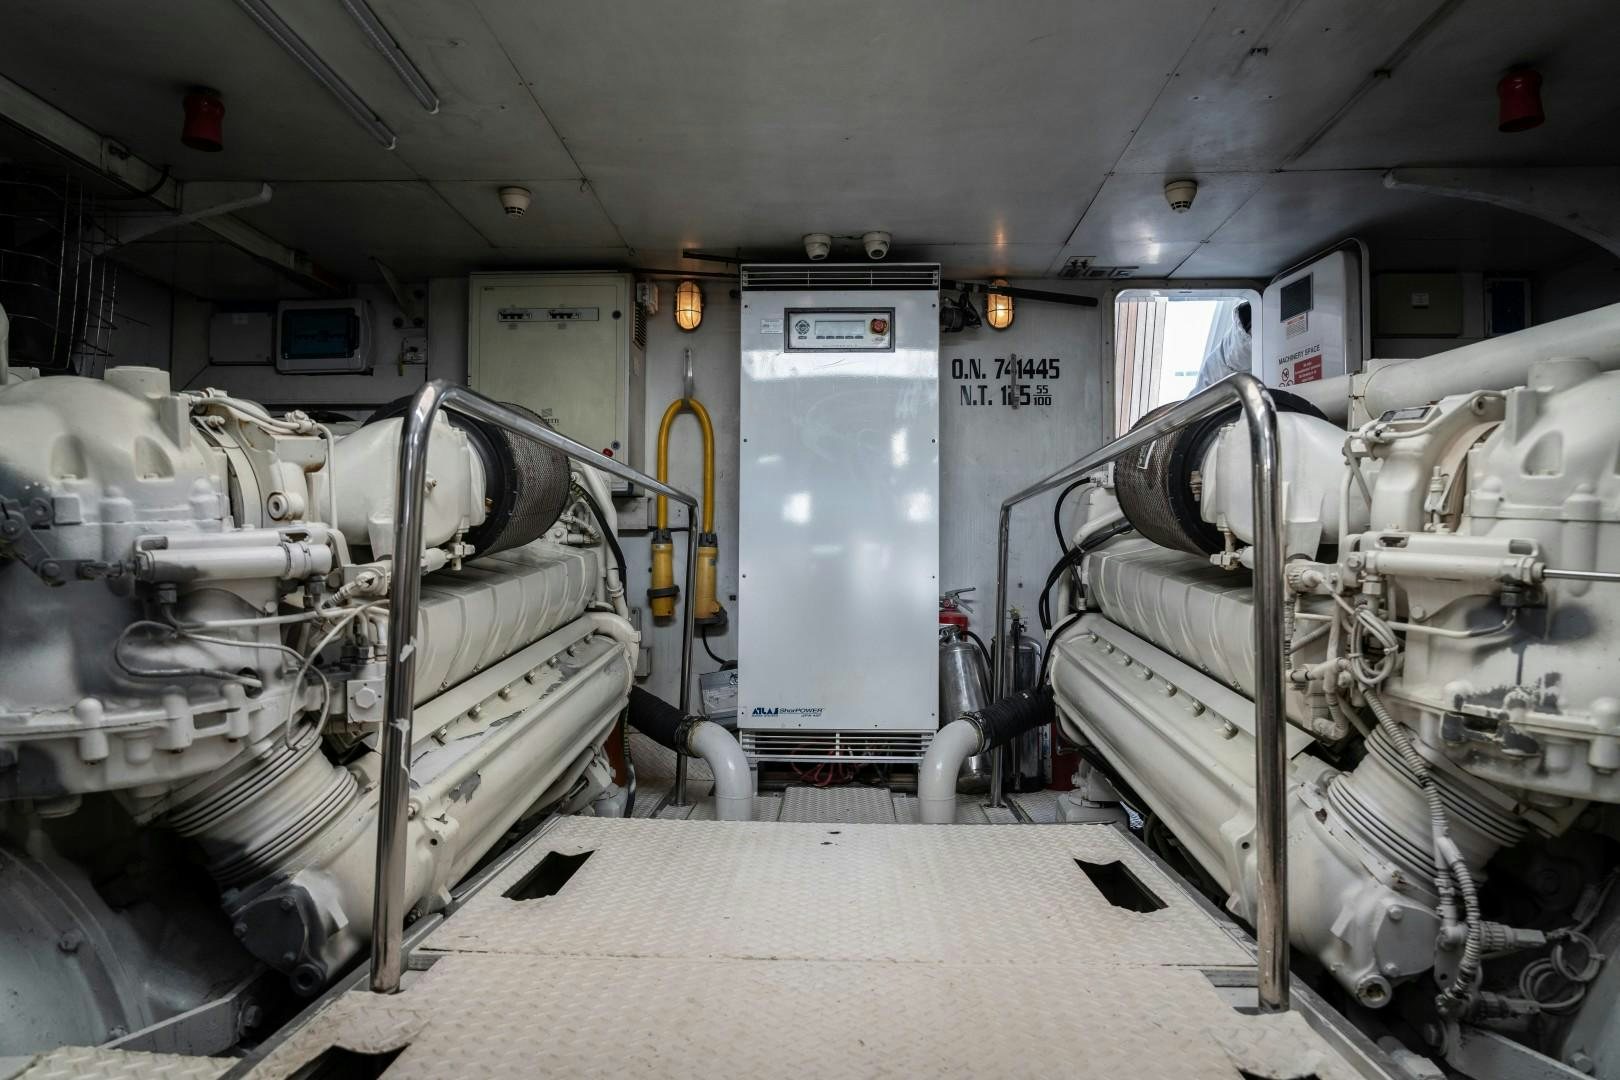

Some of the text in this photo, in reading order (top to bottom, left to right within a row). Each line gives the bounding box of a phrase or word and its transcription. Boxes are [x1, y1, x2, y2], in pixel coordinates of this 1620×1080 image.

[1279, 345, 1320, 365] MACHINERY SPACE
[952, 359, 986, 379] O.N.
[960, 385, 1051, 405] N.T. 15 55 100
[752, 707, 779, 715] ATLAS
